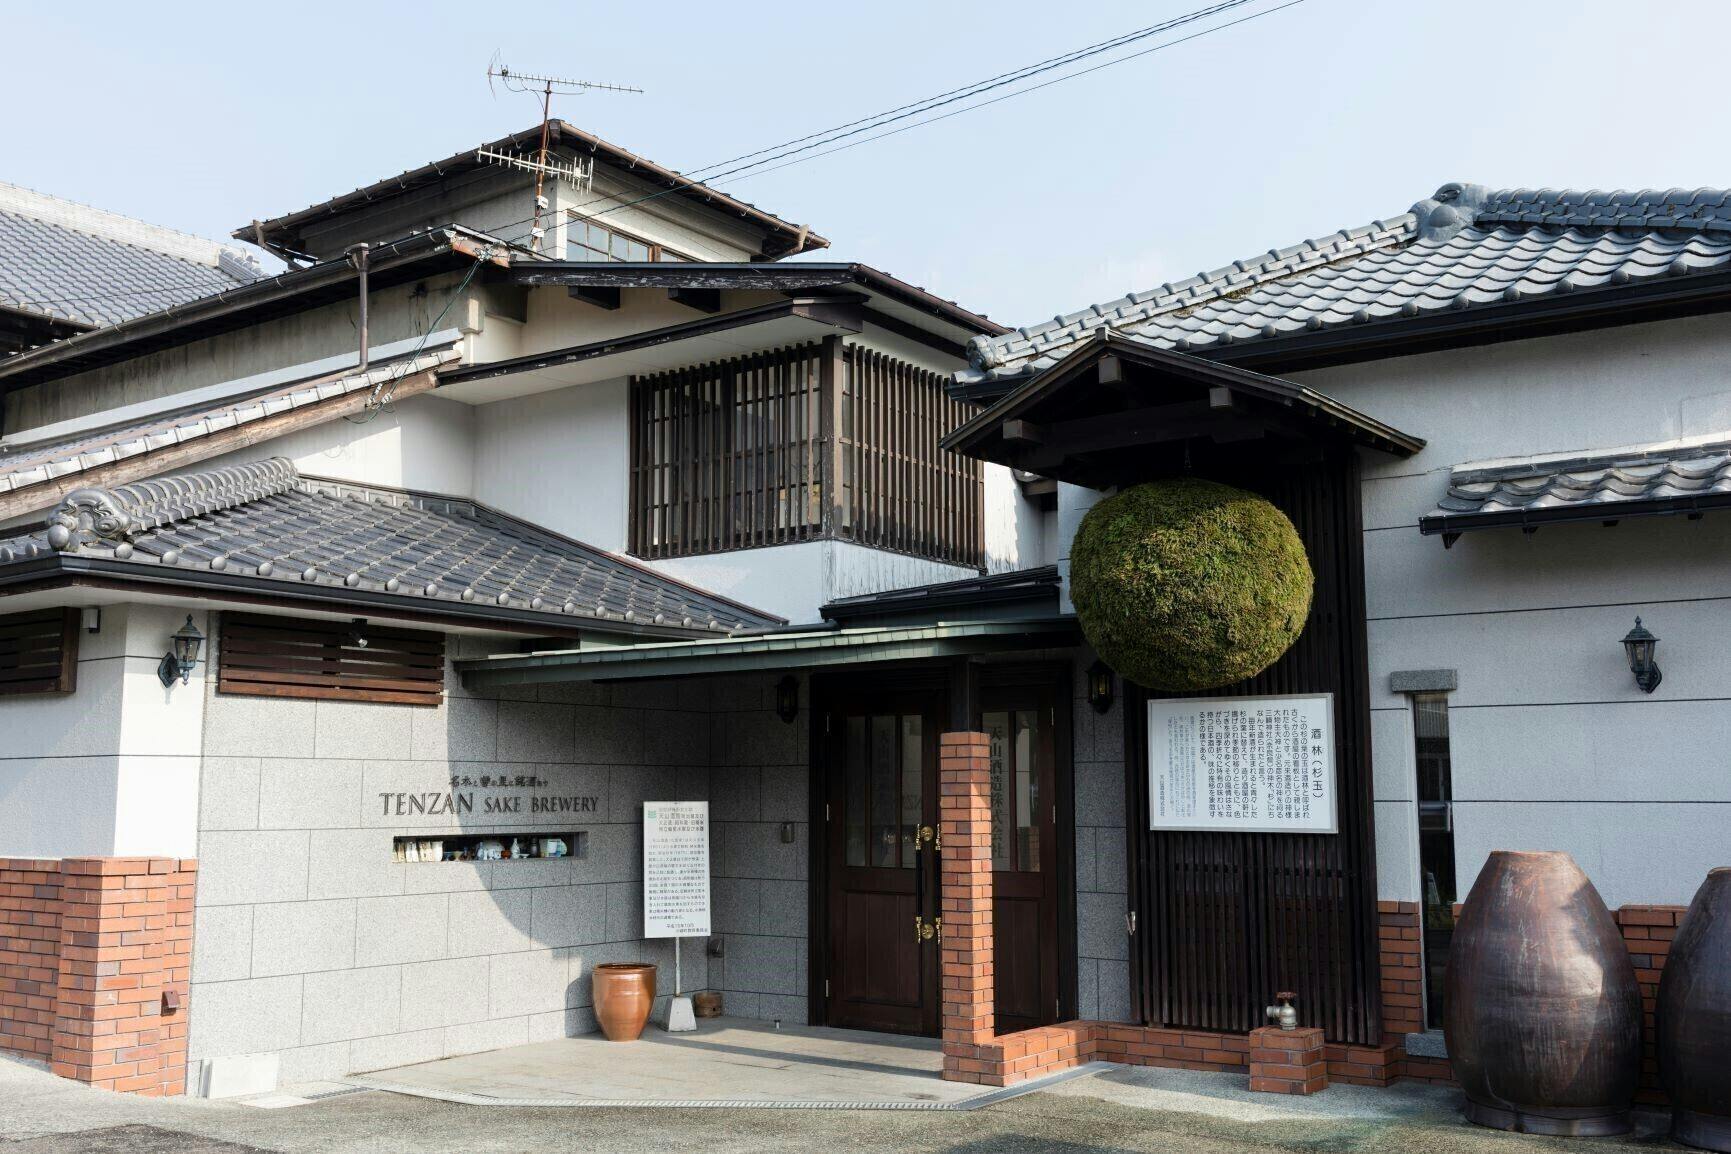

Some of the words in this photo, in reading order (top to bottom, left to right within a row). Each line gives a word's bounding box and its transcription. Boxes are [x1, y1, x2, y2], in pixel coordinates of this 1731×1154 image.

[378, 792, 474, 815] TENZAN
[483, 796, 522, 813] SAKE
[531, 796, 599, 813] BREWERY
